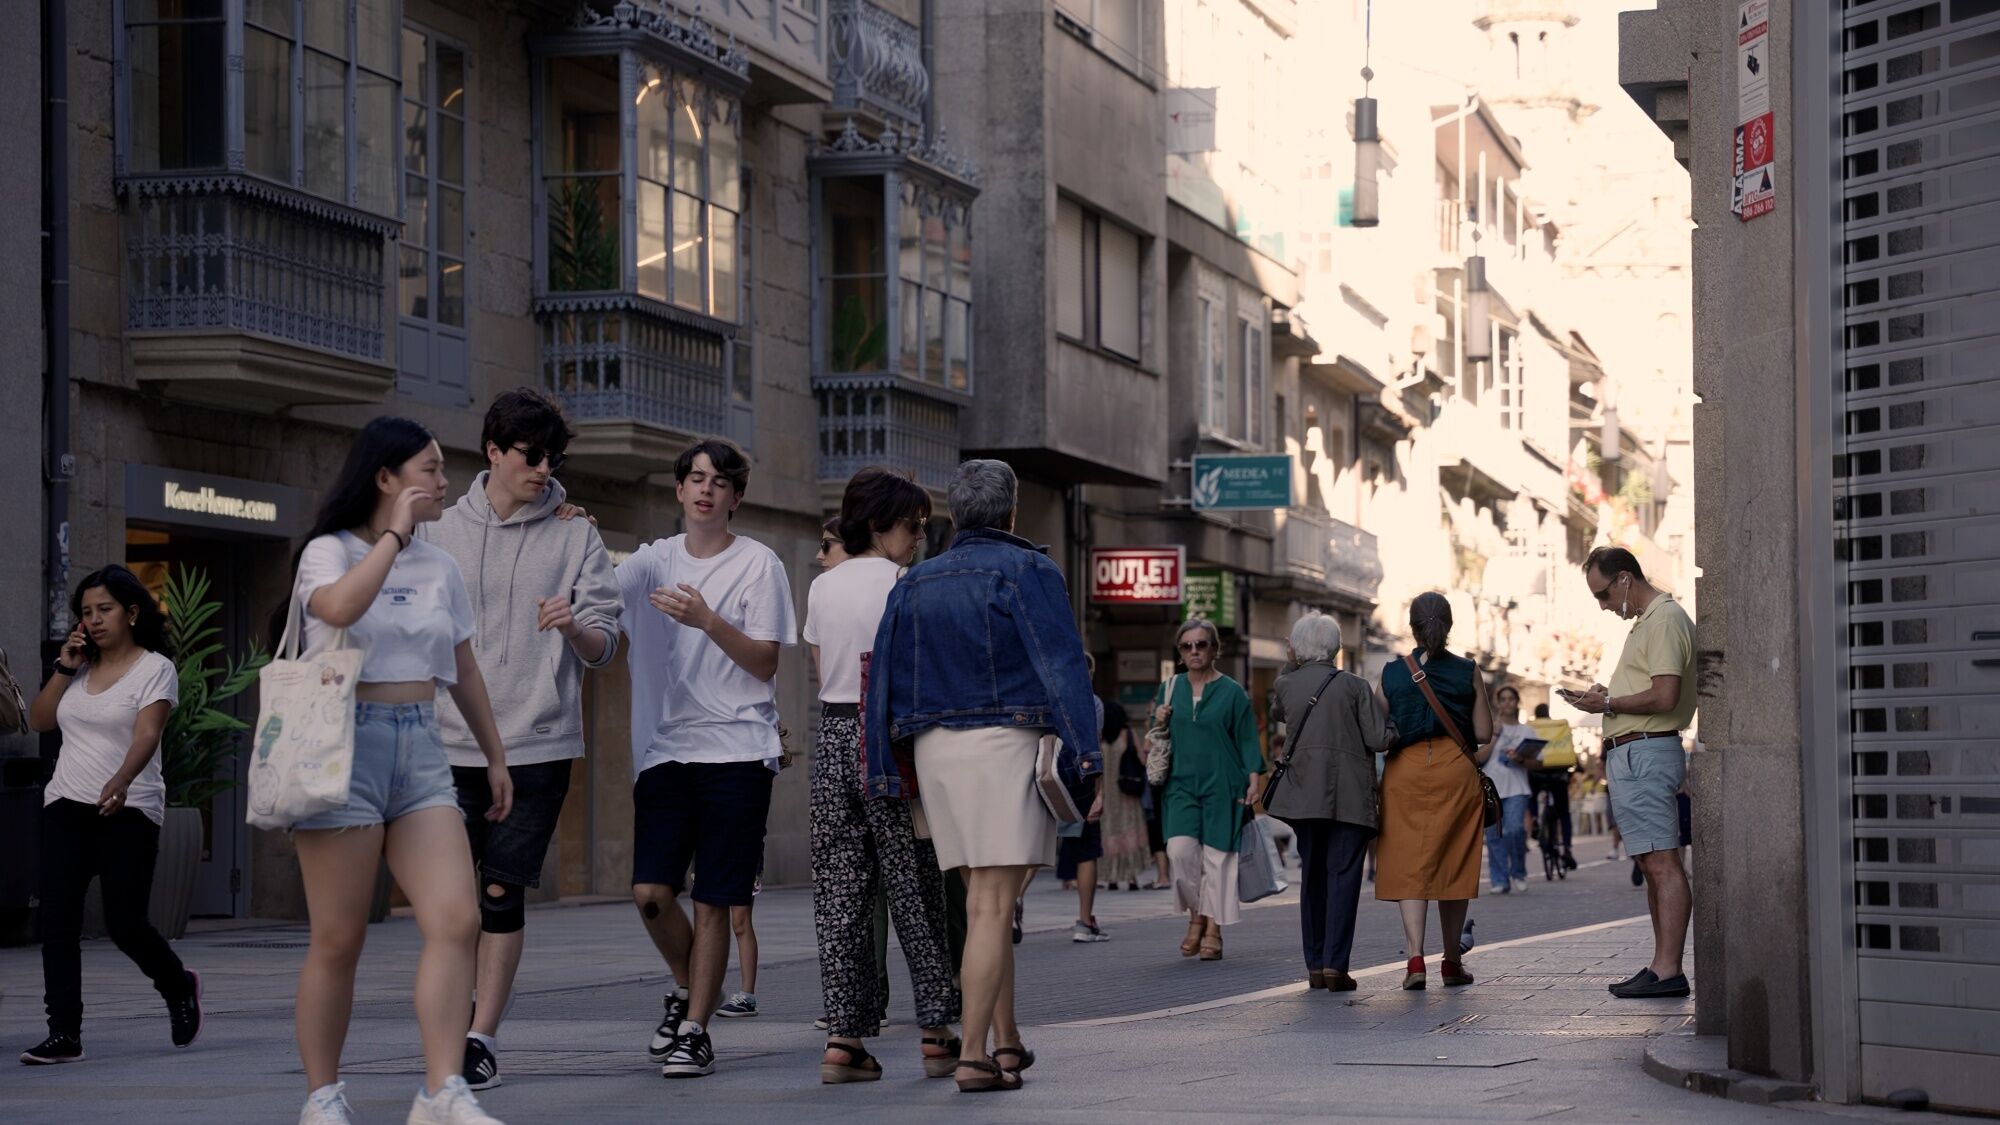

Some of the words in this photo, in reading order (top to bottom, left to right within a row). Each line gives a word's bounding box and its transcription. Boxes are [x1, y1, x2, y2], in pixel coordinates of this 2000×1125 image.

[1734, 131, 1745, 214] ALARMA
[1223, 467, 1268, 480] MEDEA
[165, 481, 277, 522] KaveHome.com
[1097, 558, 1175, 585] OUTLET
[1132, 583, 1178, 599] Shoes
